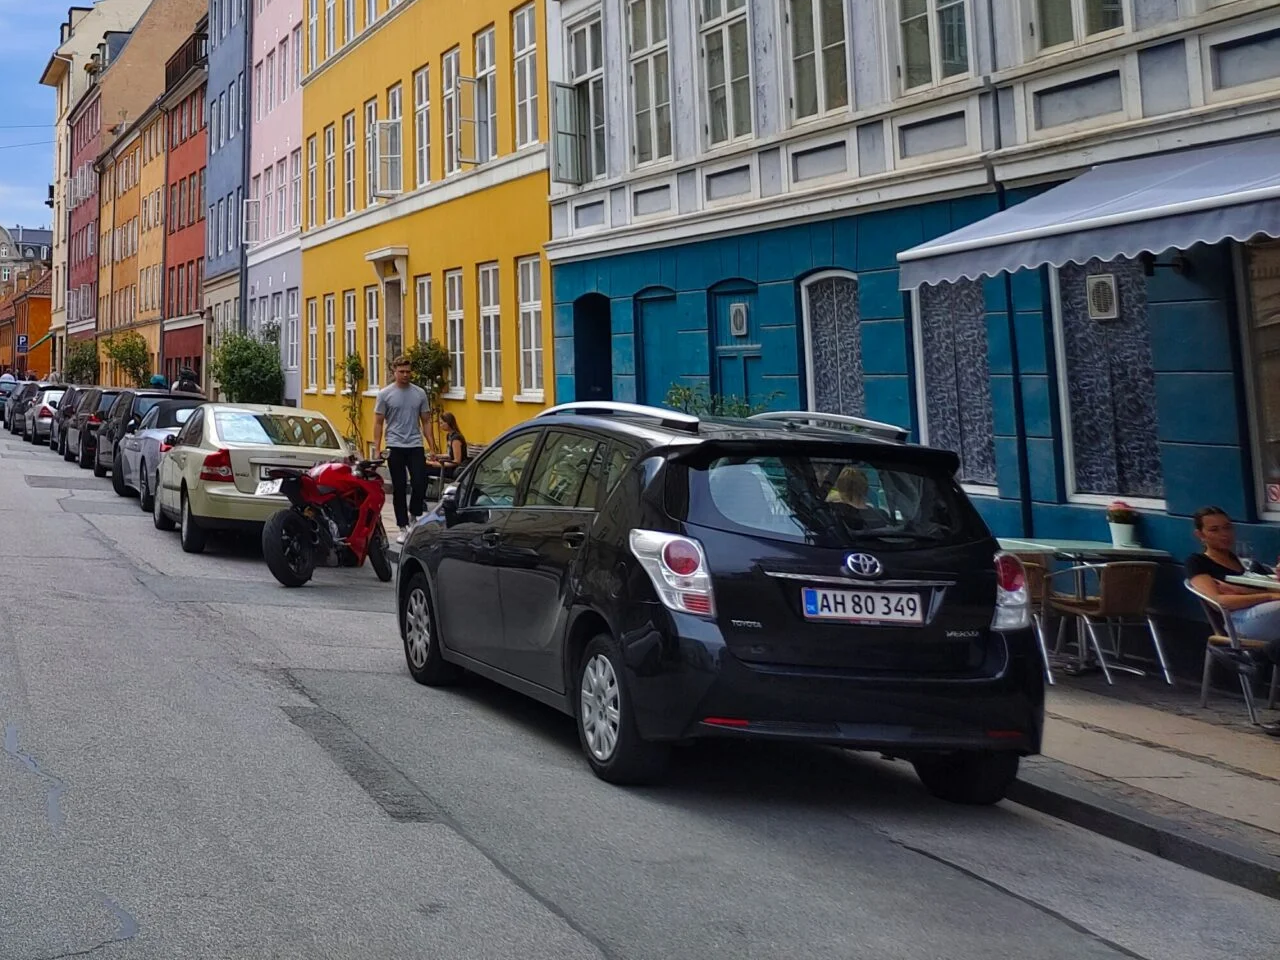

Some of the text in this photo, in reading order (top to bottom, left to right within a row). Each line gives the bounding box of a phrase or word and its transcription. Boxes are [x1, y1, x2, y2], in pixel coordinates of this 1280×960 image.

[20, 336, 27, 345] P
[820, 594, 917, 616] AH 80 349
[731, 619, 762, 628] TOYOTA
